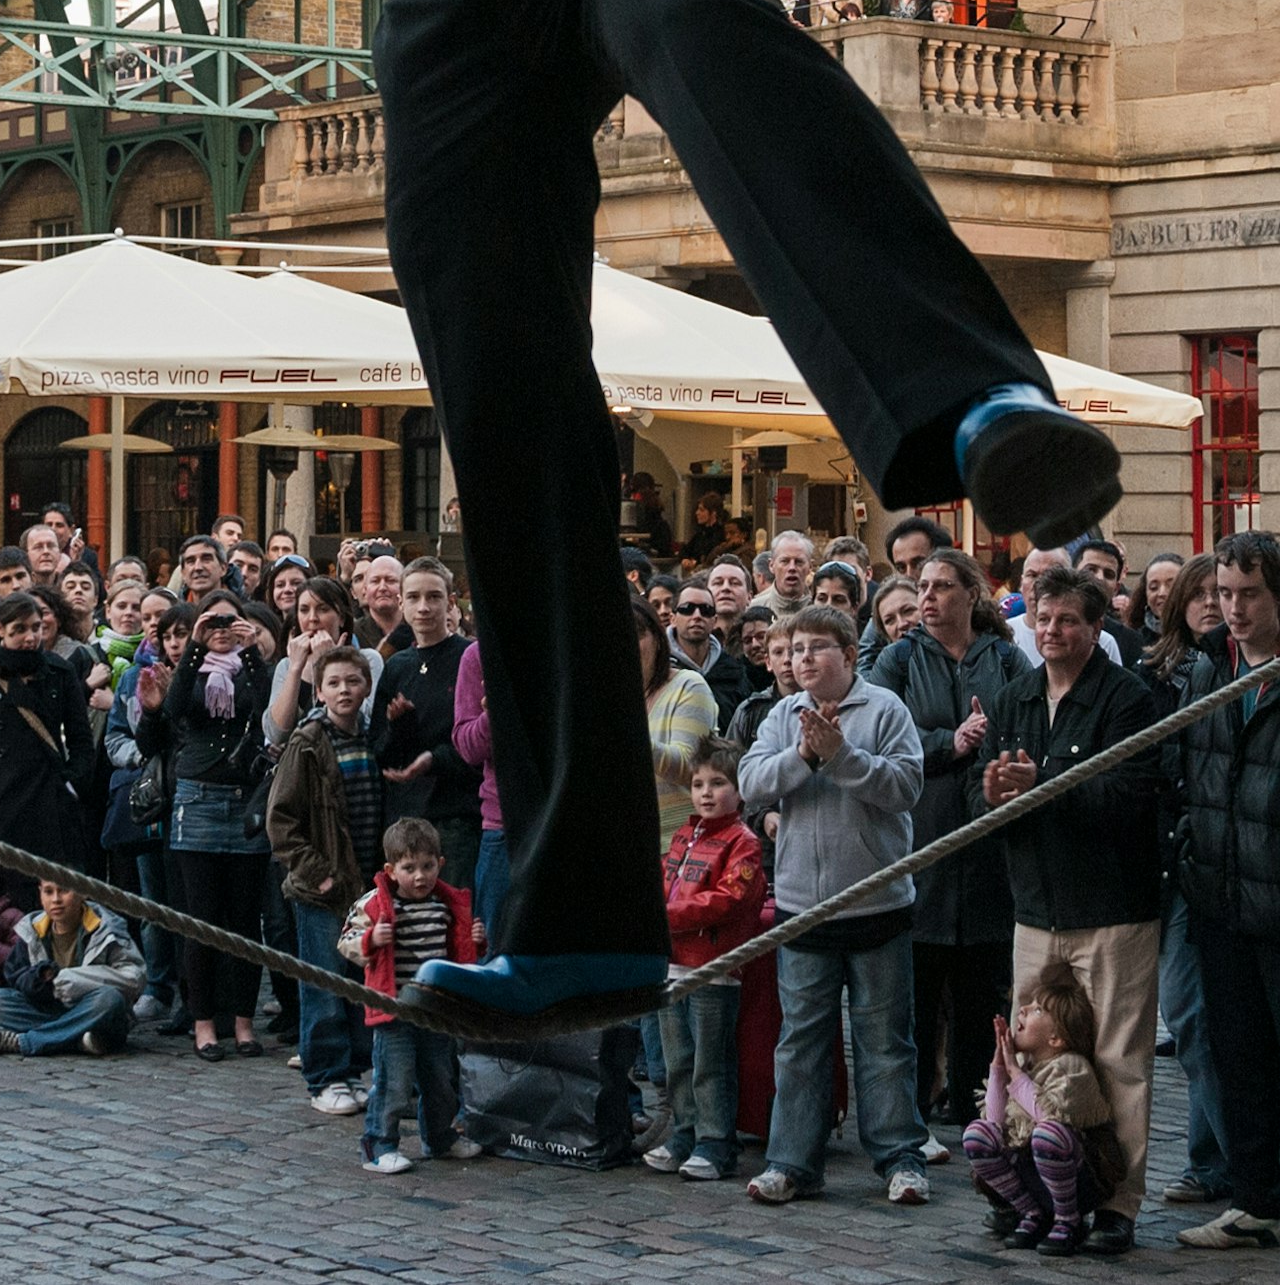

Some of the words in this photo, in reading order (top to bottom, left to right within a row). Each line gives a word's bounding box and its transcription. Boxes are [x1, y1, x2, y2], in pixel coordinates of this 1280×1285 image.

[1150, 218, 1238, 246] BUTLER
[41, 370, 95, 391] pizza
[101, 367, 160, 390] pasta
[168, 364, 210, 385] vino
[220, 369, 338, 384] FUEL
[360, 362, 402, 383] café
[616, 382, 663, 404] pasta
[669, 382, 703, 403] vino
[711, 389, 807, 406] FUEL
[510, 1133, 544, 1150] Marc
[545, 1141, 587, 1158] O'Polo
